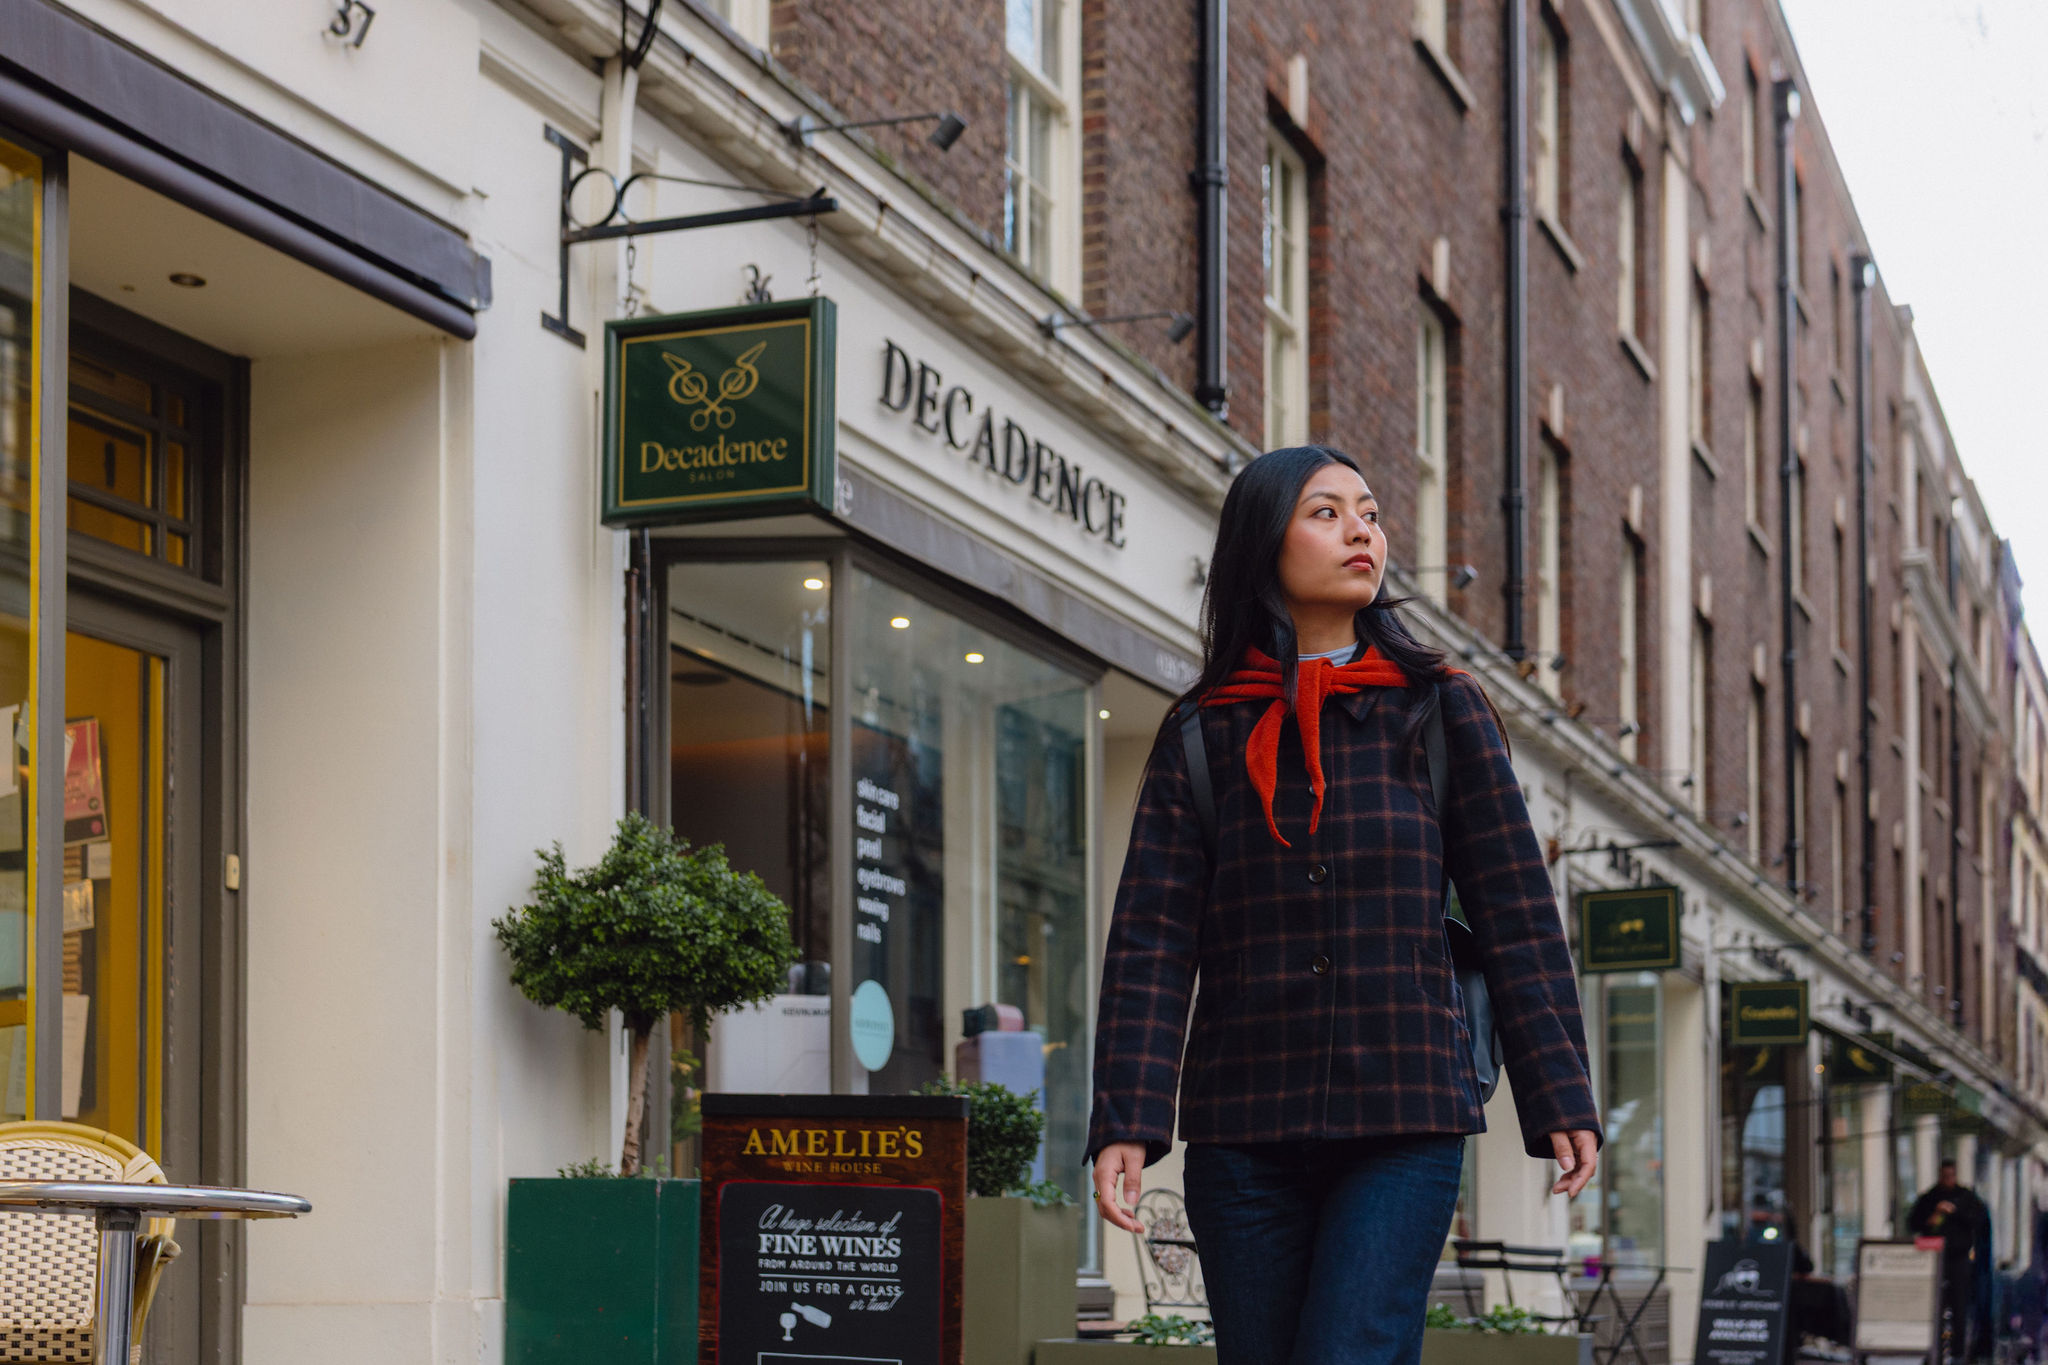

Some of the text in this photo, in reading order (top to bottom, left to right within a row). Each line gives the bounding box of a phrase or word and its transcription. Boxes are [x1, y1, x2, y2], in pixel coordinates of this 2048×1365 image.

[640, 434, 789, 473] Decadence
[879, 338, 1126, 549] DECADENCE
[688, 469, 736, 484] SALON
[856, 804, 886, 833] facial
[857, 867, 906, 896] eyebrows
[857, 922, 881, 944] nails
[741, 1125, 924, 1158] AMELIE'S
[782, 1161, 882, 1174] WINE HOUSE
[778, 1208, 813, 1236] huge
[814, 1209, 877, 1232] selection
[878, 1211, 903, 1239] of
[758, 1233, 901, 1258] FINE WINES
[758, 1258, 899, 1273] FROM AROUND THE WORLD
[759, 1280, 901, 1297] JOIN US FOR A GLASS
